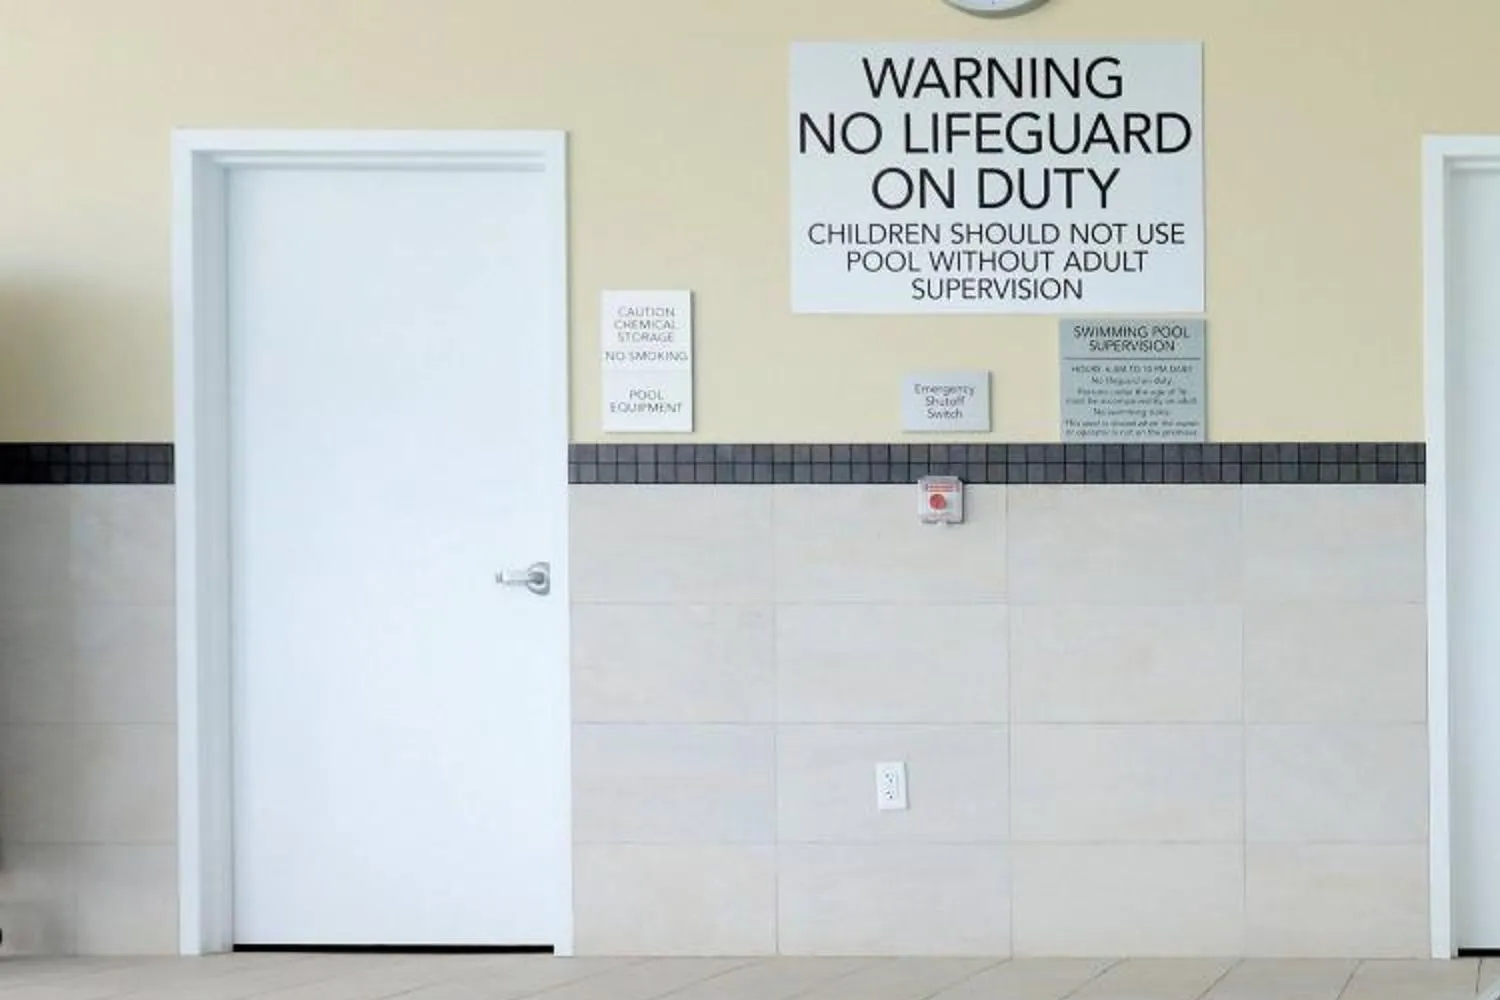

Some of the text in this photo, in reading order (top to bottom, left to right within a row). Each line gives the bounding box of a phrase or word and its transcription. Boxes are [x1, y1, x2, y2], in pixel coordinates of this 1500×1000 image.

[863, 56, 1123, 100] WARNING
[799, 111, 1193, 155] NO LIFEGUARD
[871, 167, 1121, 210] ON DUTY
[807, 222, 1185, 245] CHILDREN SHOULD NOT USE
[847, 249, 1149, 273] POOL WITHOUT ADULT
[911, 277, 1083, 300] SUPERVISION
[617, 307, 675, 317] CAUTION
[614, 320, 678, 329] CHEMICAL
[617, 332, 674, 342] STORAGE
[1073, 325, 1191, 339] SWIMMING POOL
[1089, 339, 1175, 352] SUPERVISION
[605, 352, 689, 361] NO SMOKING
[629, 389, 664, 401] POOL
[914, 384, 975, 397] Emergency
[610, 402, 682, 413] EQUIPMENT
[927, 408, 963, 419] Switch
